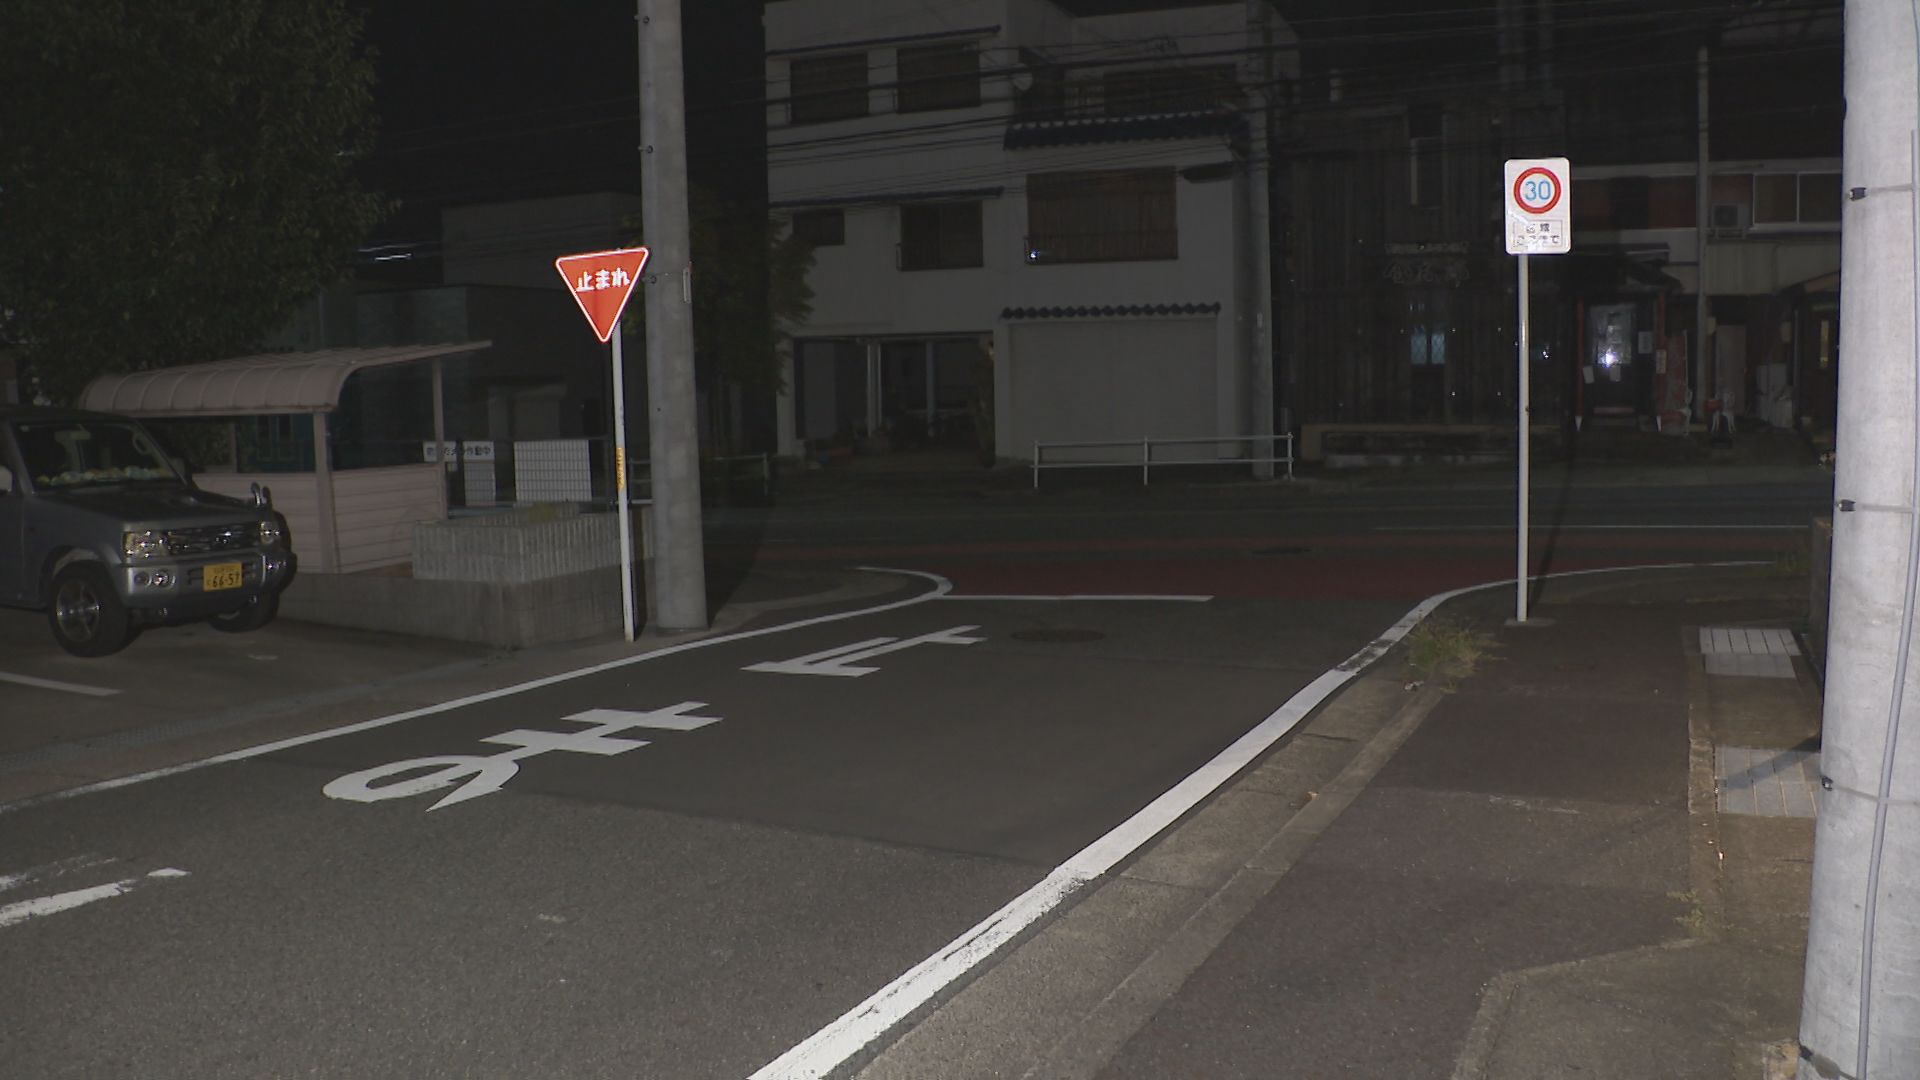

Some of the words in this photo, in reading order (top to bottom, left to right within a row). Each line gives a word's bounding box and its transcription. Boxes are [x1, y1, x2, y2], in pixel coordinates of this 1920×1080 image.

[1525, 180, 1551, 201] 30
[575, 267, 631, 292] 止まれ
